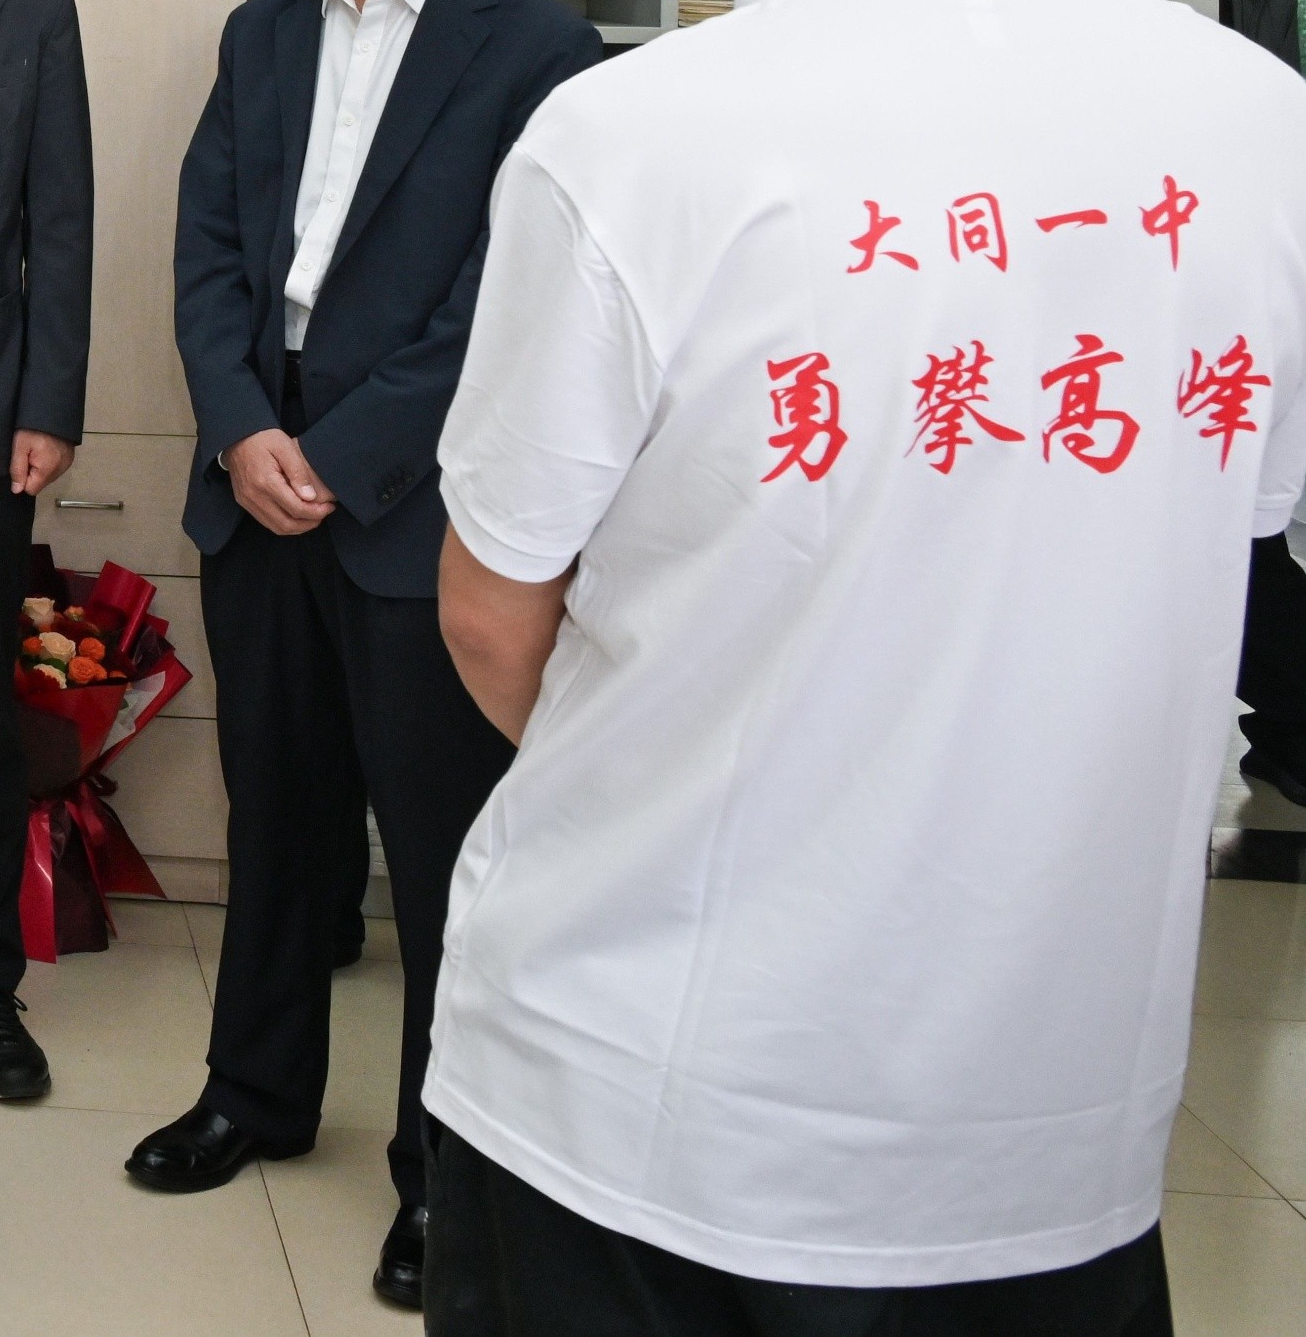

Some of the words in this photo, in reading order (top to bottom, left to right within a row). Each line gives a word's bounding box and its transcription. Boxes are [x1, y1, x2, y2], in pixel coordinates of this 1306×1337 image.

[846, 175, 1200, 274] 大同一中
[760, 334, 1272, 483] 勇攀高峰
